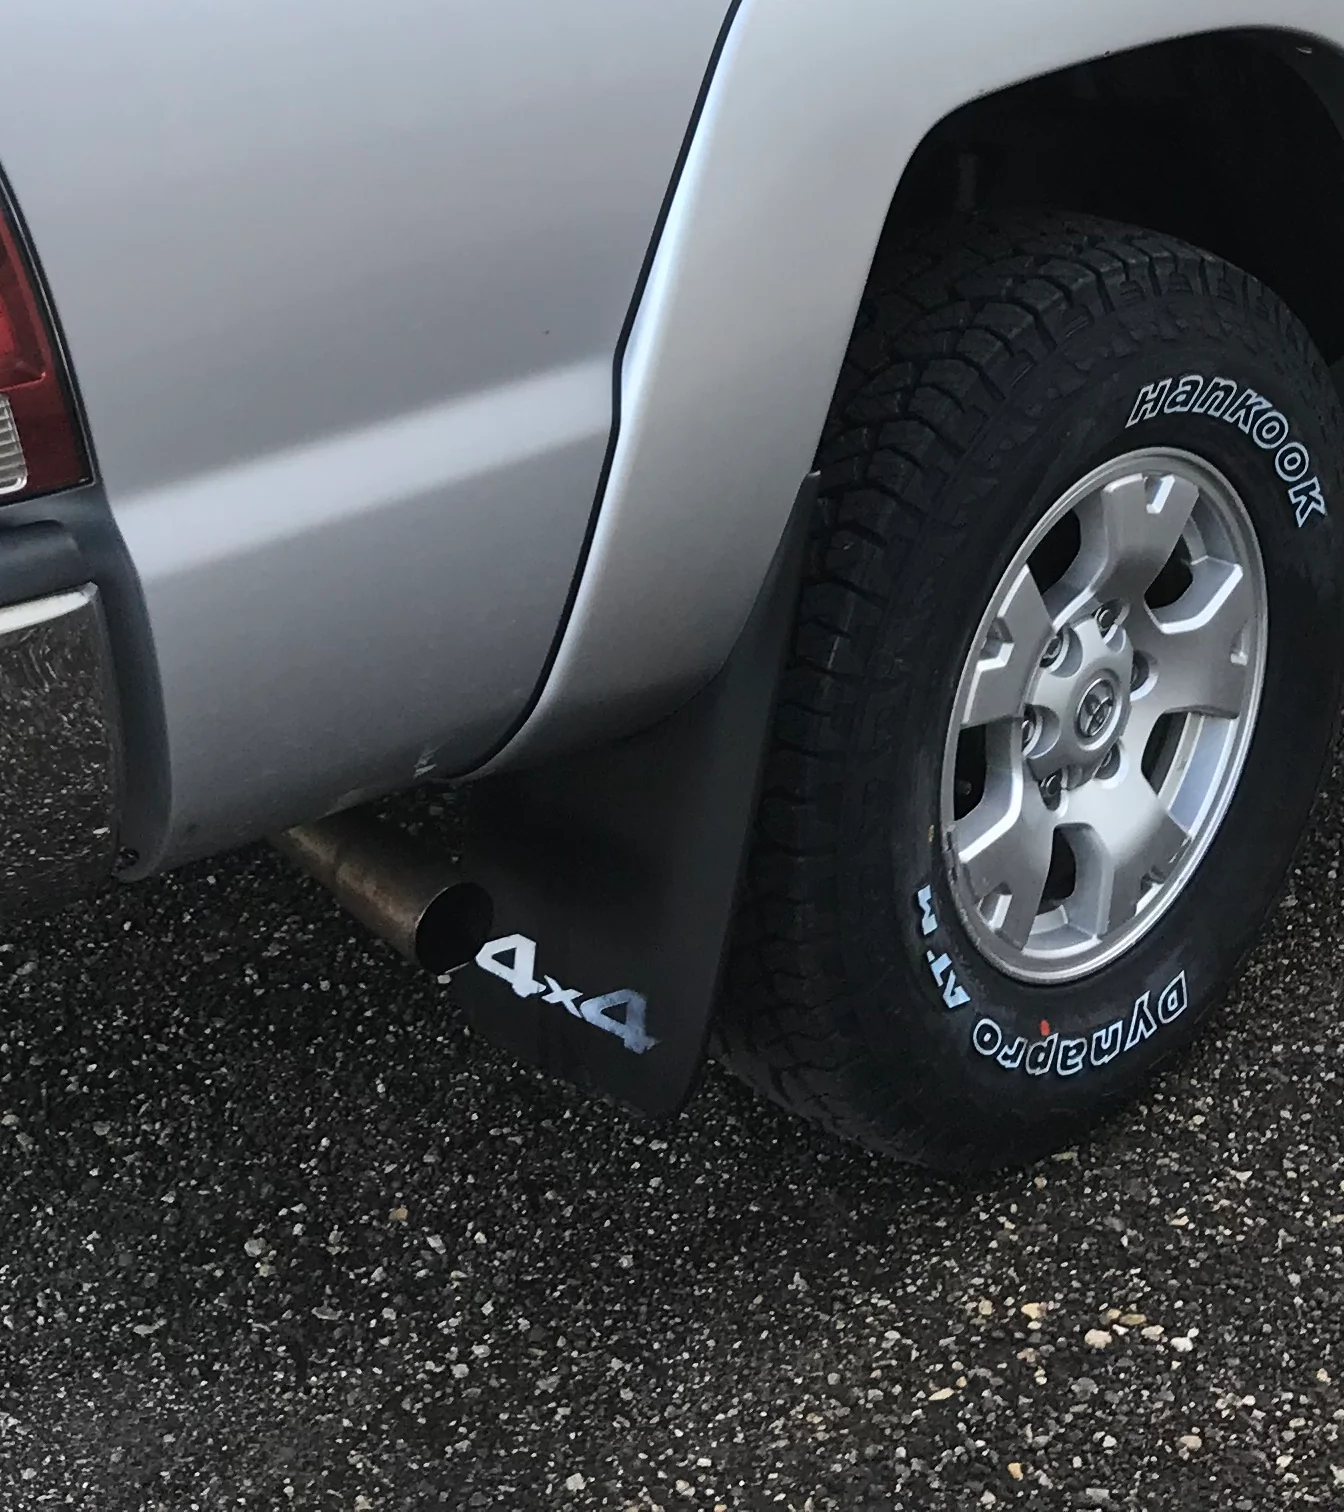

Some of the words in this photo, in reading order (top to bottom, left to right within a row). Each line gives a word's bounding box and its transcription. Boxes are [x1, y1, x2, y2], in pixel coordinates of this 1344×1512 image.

[1124, 374, 1328, 528] Hankook
[475, 933, 661, 1055] 4x4
[973, 970, 1189, 1076] Dynapro
